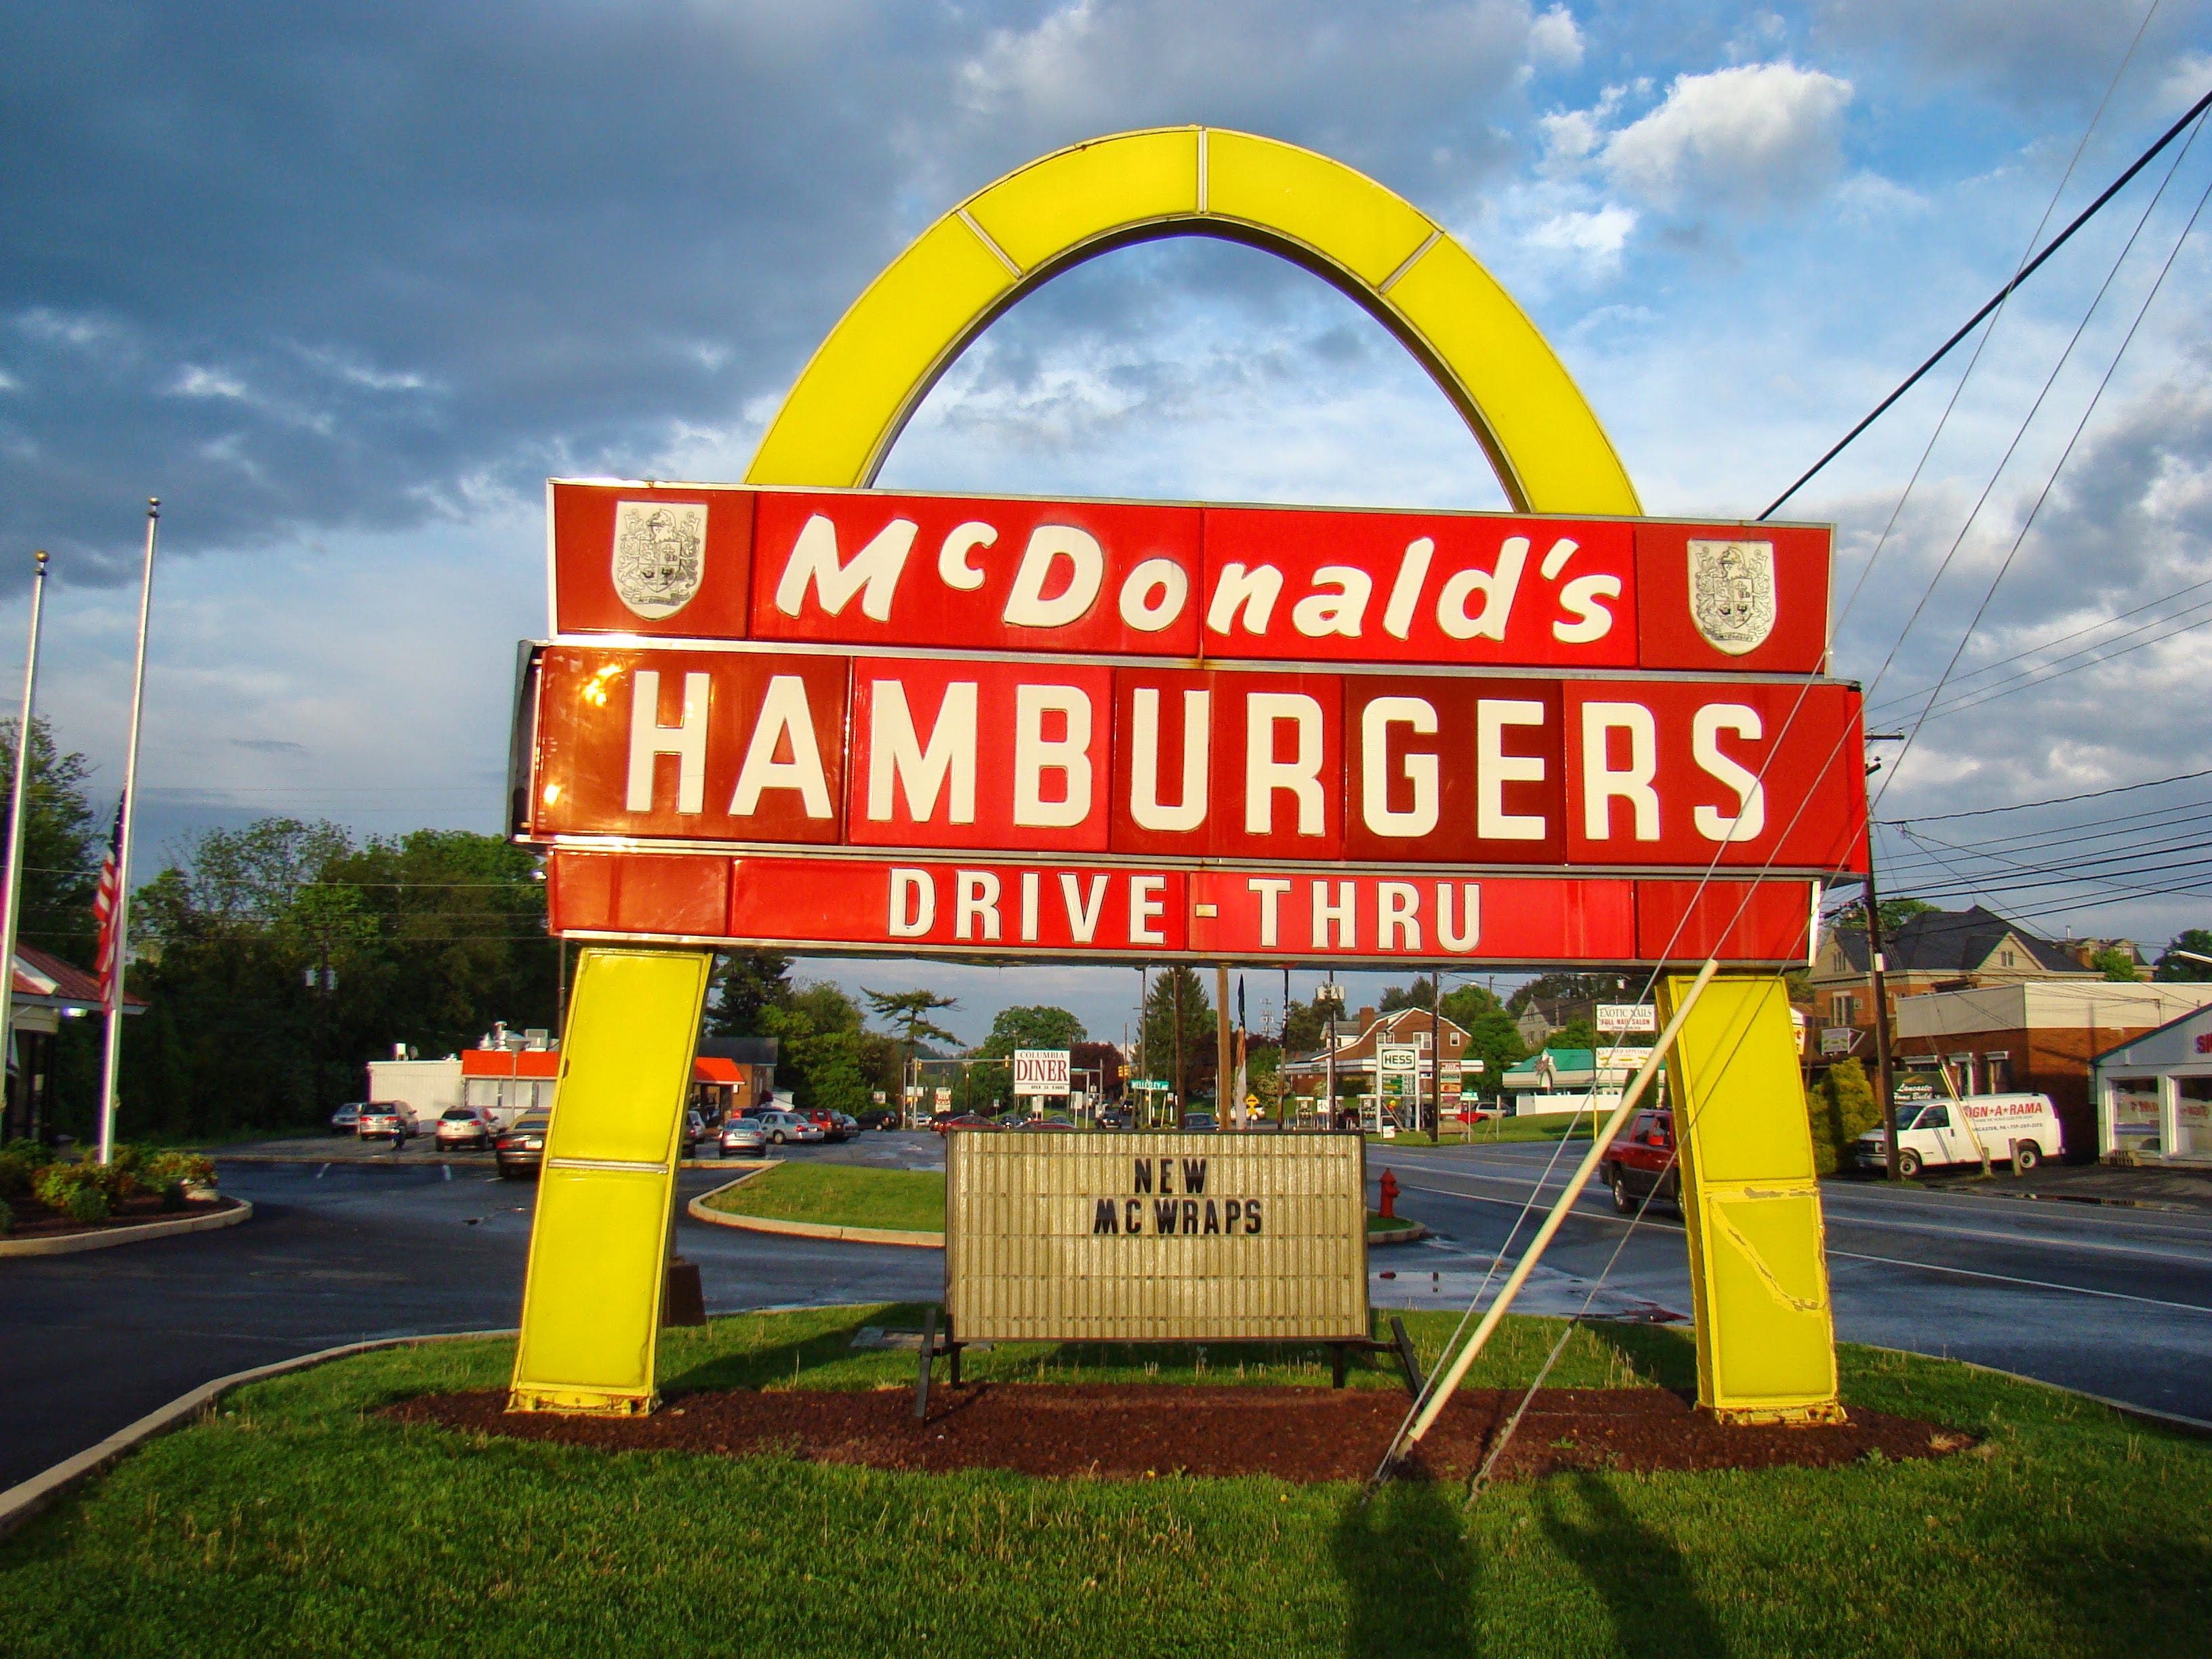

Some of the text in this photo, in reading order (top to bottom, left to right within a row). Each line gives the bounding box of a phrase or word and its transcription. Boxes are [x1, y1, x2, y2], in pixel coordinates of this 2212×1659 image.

[775, 513, 1622, 644] McDonald's
[626, 670, 1765, 842] HAMBURGERS
[1600, 1008, 1628, 1017] EXOTIC
[1017, 1059, 1068, 1081] DINER
[1385, 1054, 1412, 1064] HESS
[1134, 1158, 1206, 1193] NEW
[1093, 1197, 1262, 1234] MC WRAPS
